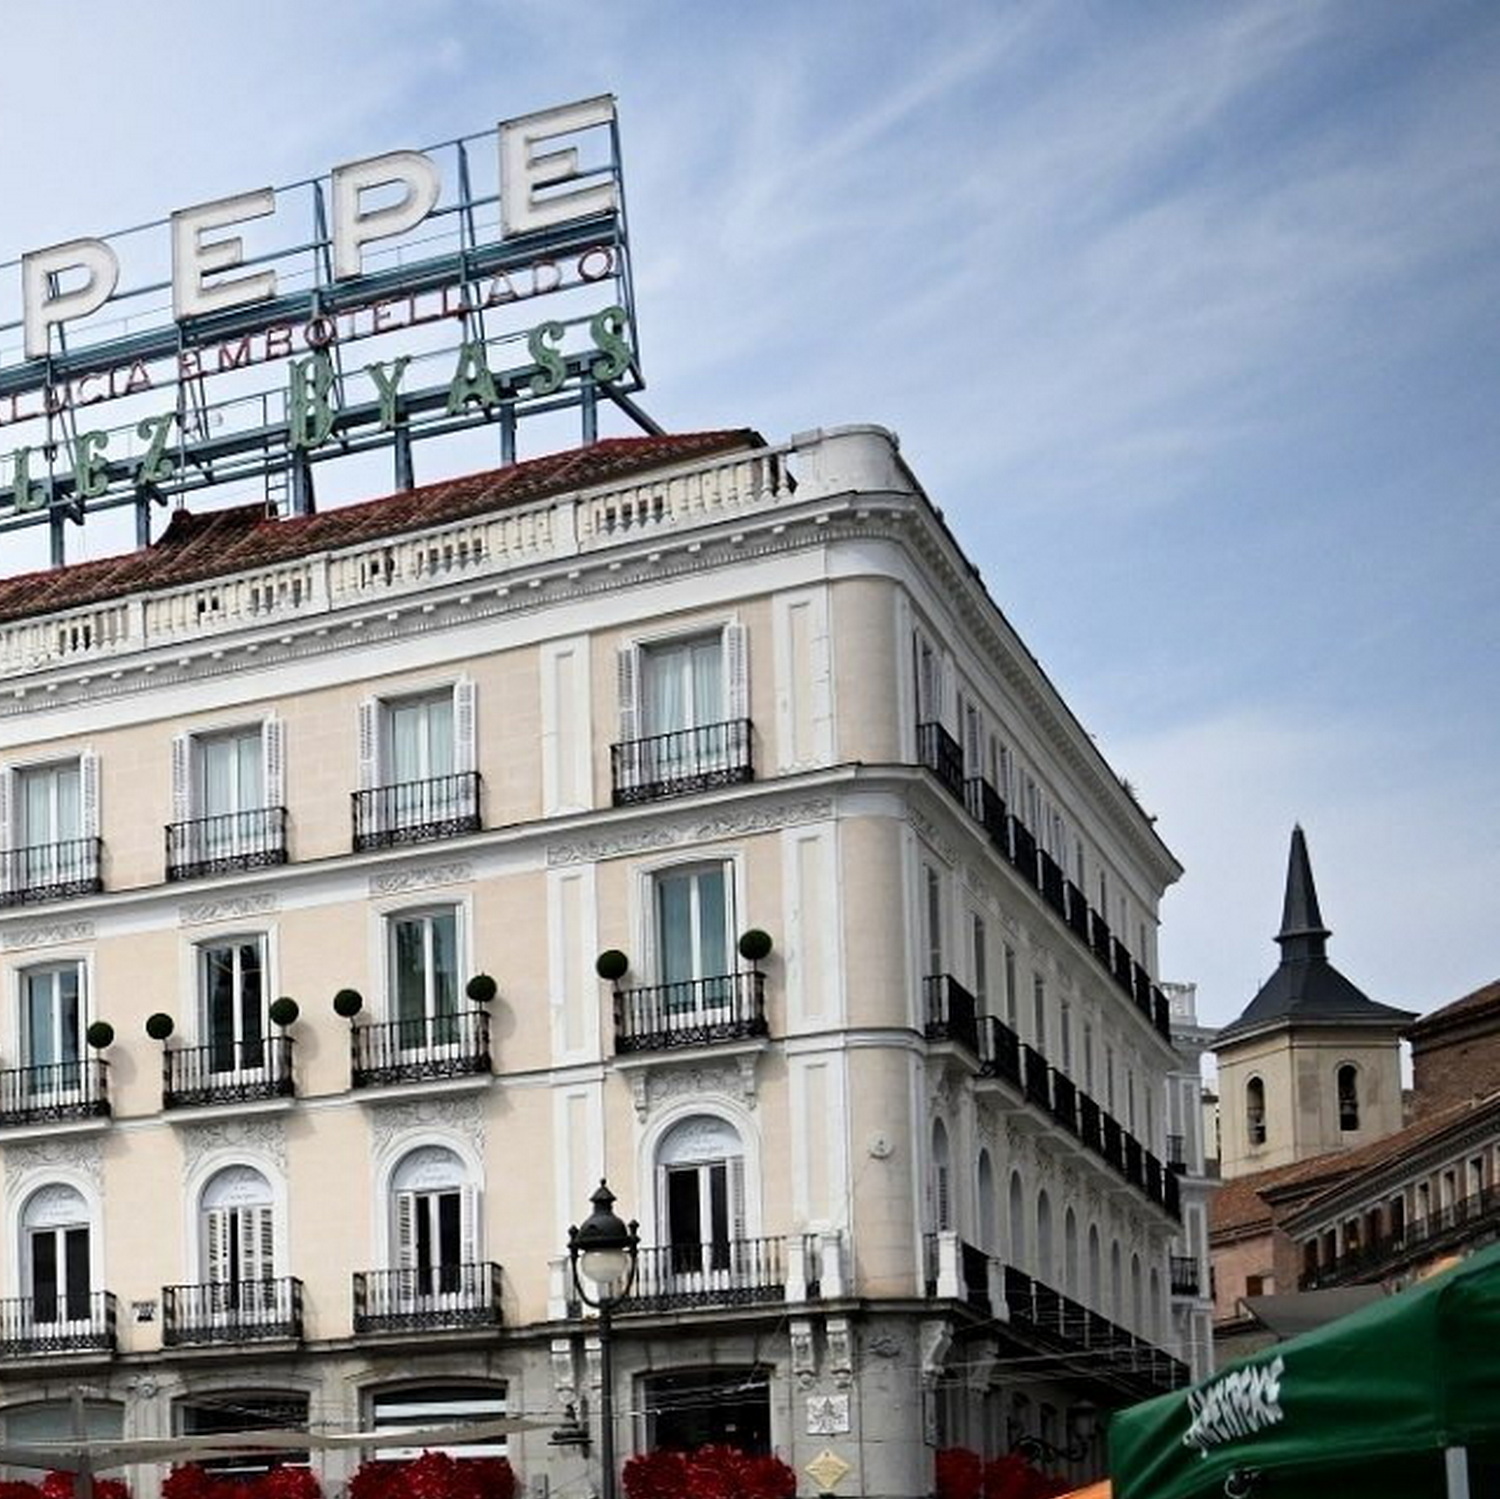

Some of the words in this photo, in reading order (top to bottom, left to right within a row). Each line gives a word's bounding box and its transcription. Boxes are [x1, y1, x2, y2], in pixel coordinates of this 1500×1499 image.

[22, 94, 616, 360] PEPE
[178, 245, 615, 380] EMBOTELLADO
[287, 304, 634, 452] BYASS
